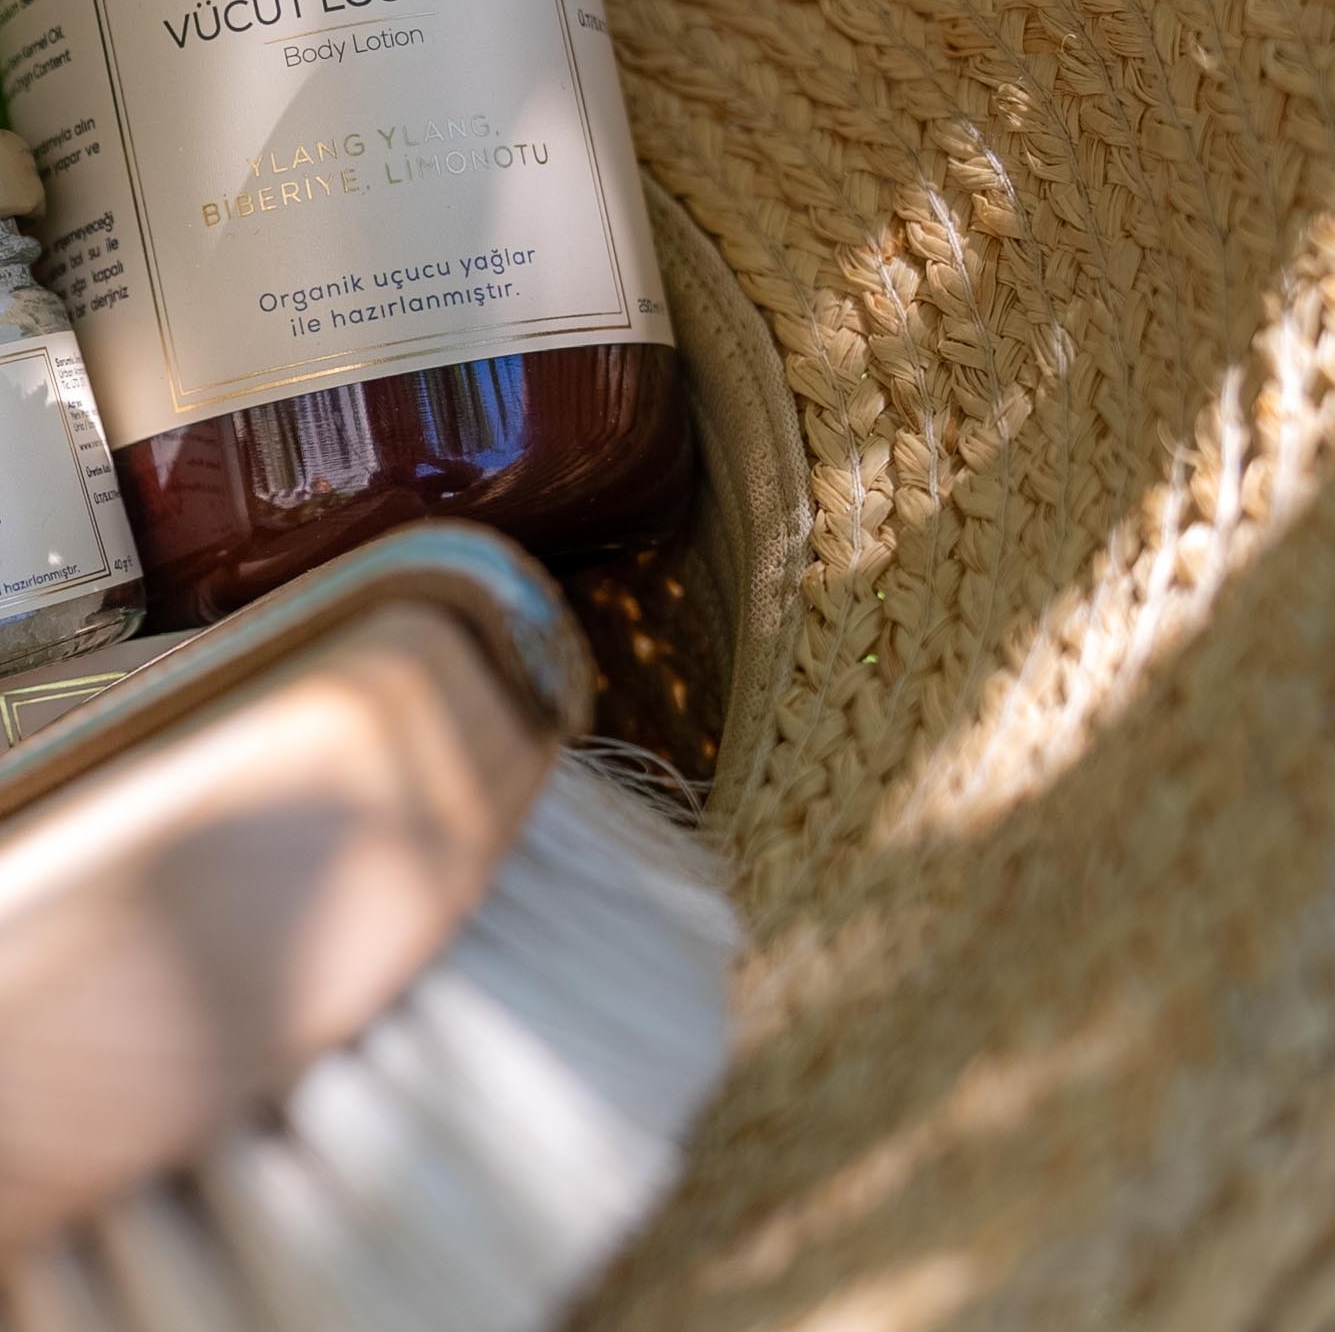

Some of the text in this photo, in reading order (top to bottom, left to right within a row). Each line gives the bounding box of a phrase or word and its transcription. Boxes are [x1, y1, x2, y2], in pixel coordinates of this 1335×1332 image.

[283, 26, 425, 68] Body Lotion
[246, 134, 366, 178] YLANG
[385, 142, 549, 185] LİMONOTU
[258, 247, 536, 313] Organik uçucu yağlar
[290, 281, 521, 337] ile hazırlanmıştır.
[3, 563, 82, 595] hazırlanmıştır.
